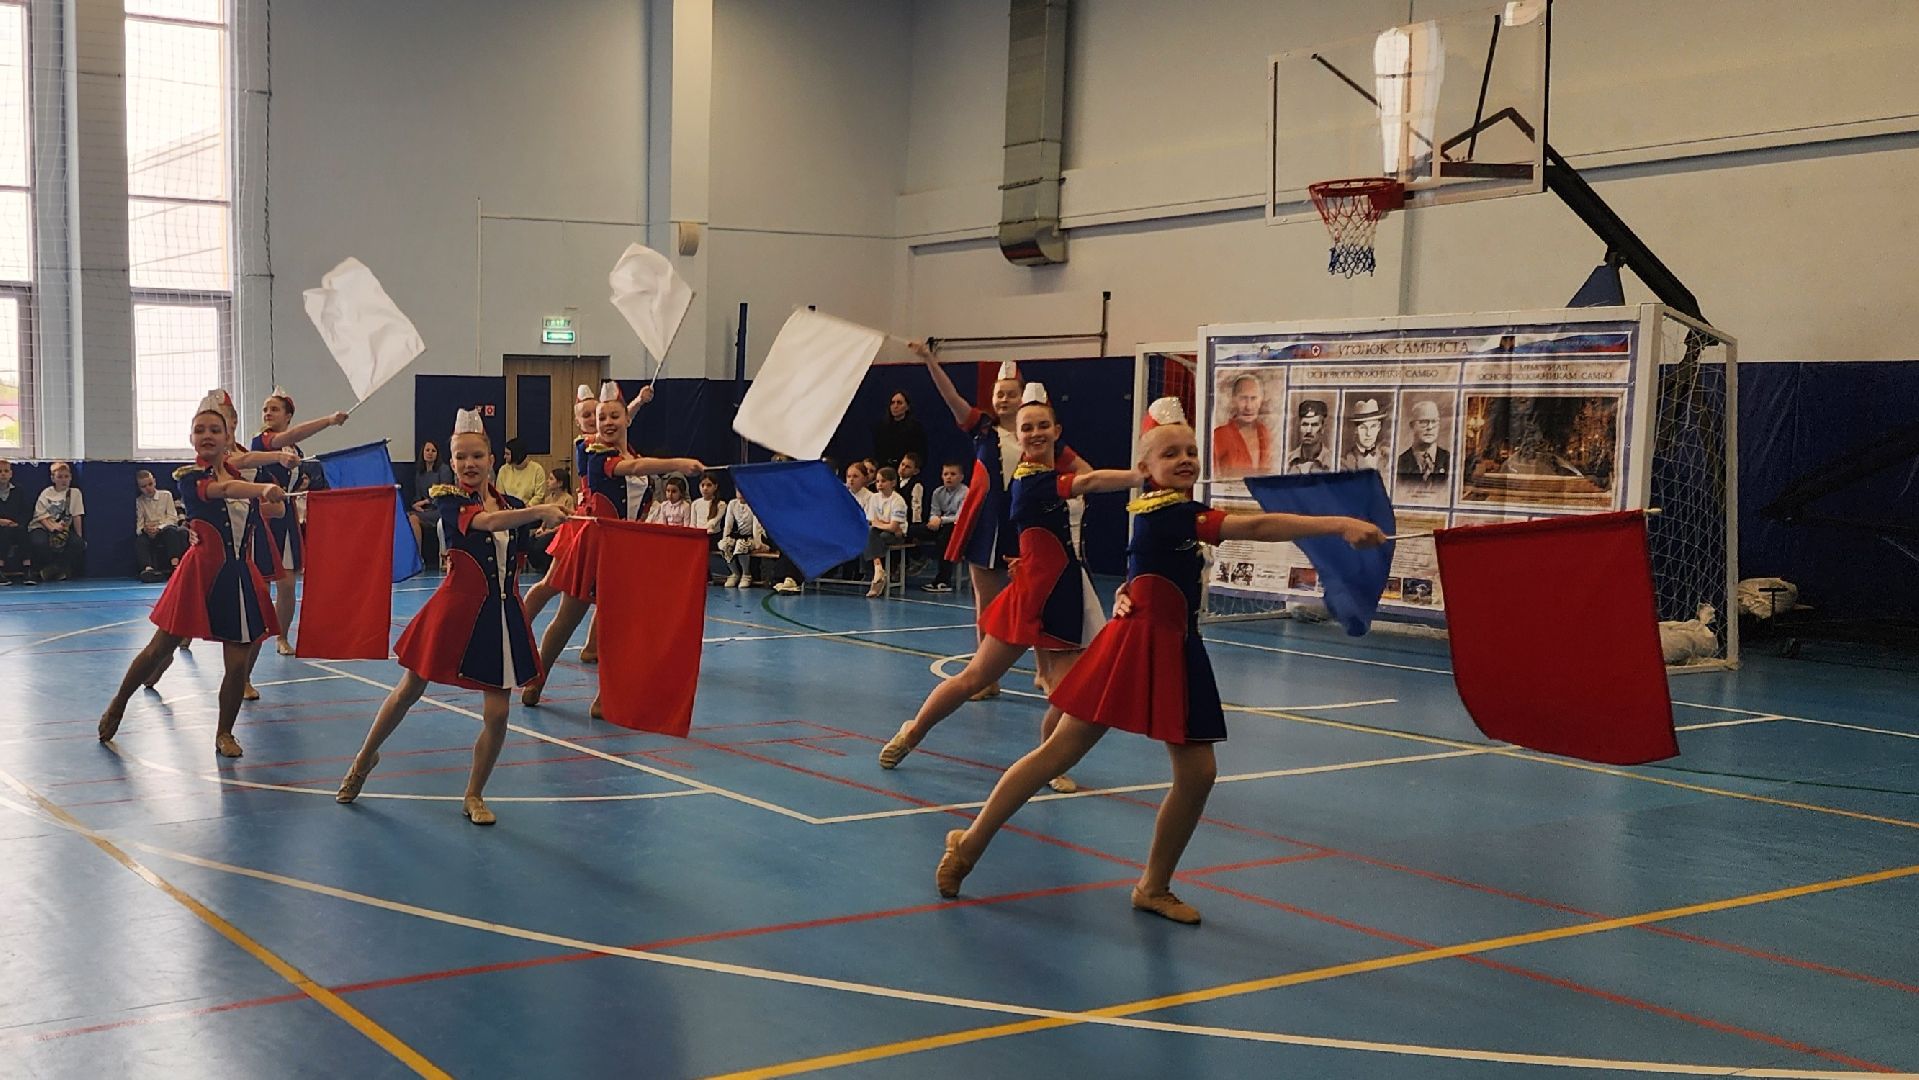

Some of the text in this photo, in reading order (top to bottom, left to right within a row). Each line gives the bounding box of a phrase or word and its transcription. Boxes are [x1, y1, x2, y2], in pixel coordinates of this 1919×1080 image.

[1339, 341, 1469, 357] УГОЛОК САМБИСТА
[1404, 368, 1439, 378] САМБО
